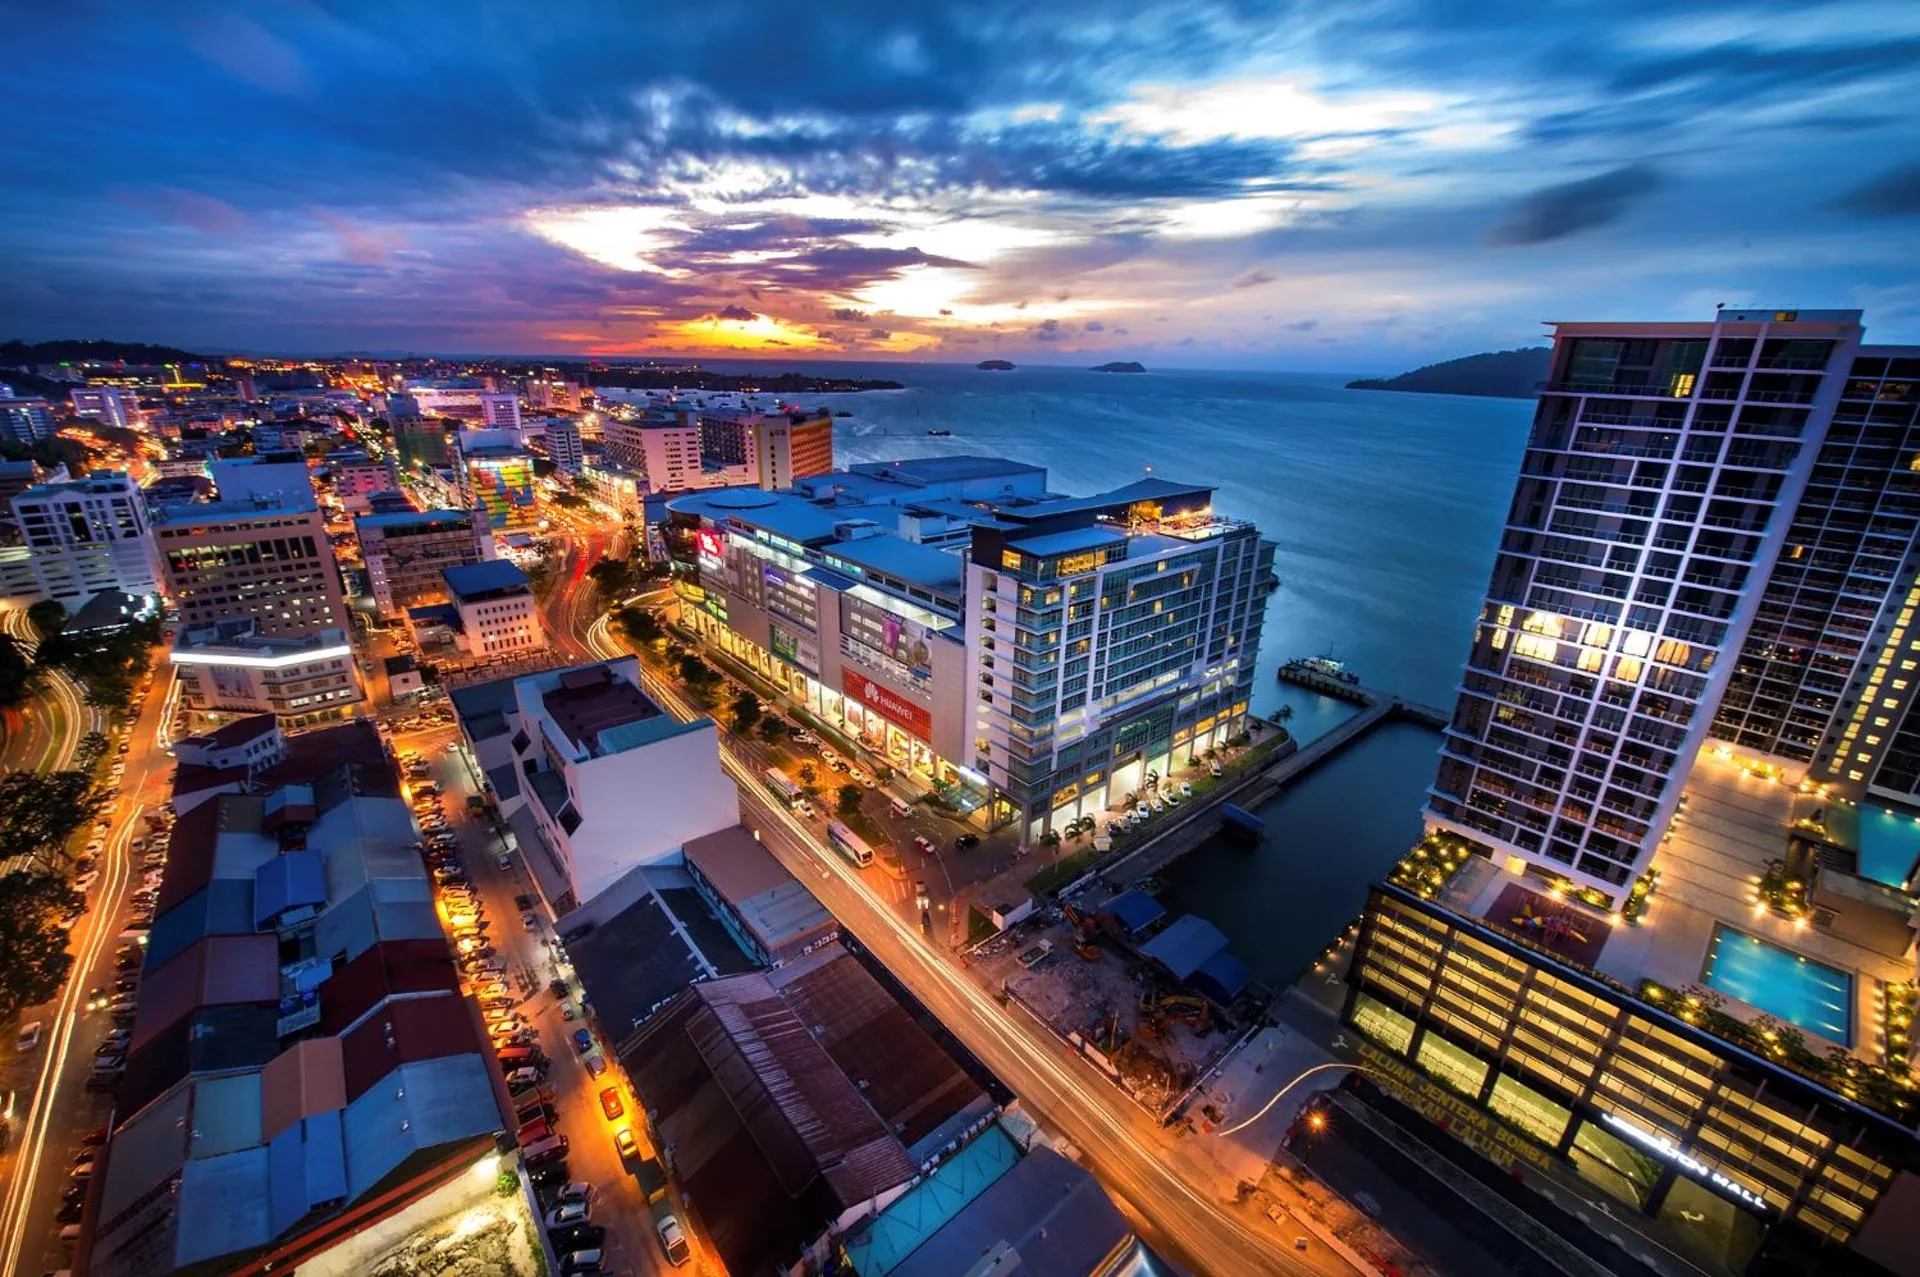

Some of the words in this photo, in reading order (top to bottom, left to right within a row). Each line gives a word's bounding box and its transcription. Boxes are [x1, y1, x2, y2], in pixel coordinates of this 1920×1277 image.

[880, 696, 913, 720] HUAWEI
[1358, 1043, 1413, 1083] LALUAN
[1419, 1083, 1490, 1131] JENTERA
[1495, 1126, 1550, 1169] BOMBA
[1449, 1119, 1514, 1167] LALUAN
[1711, 1171, 1767, 1209] MALL
